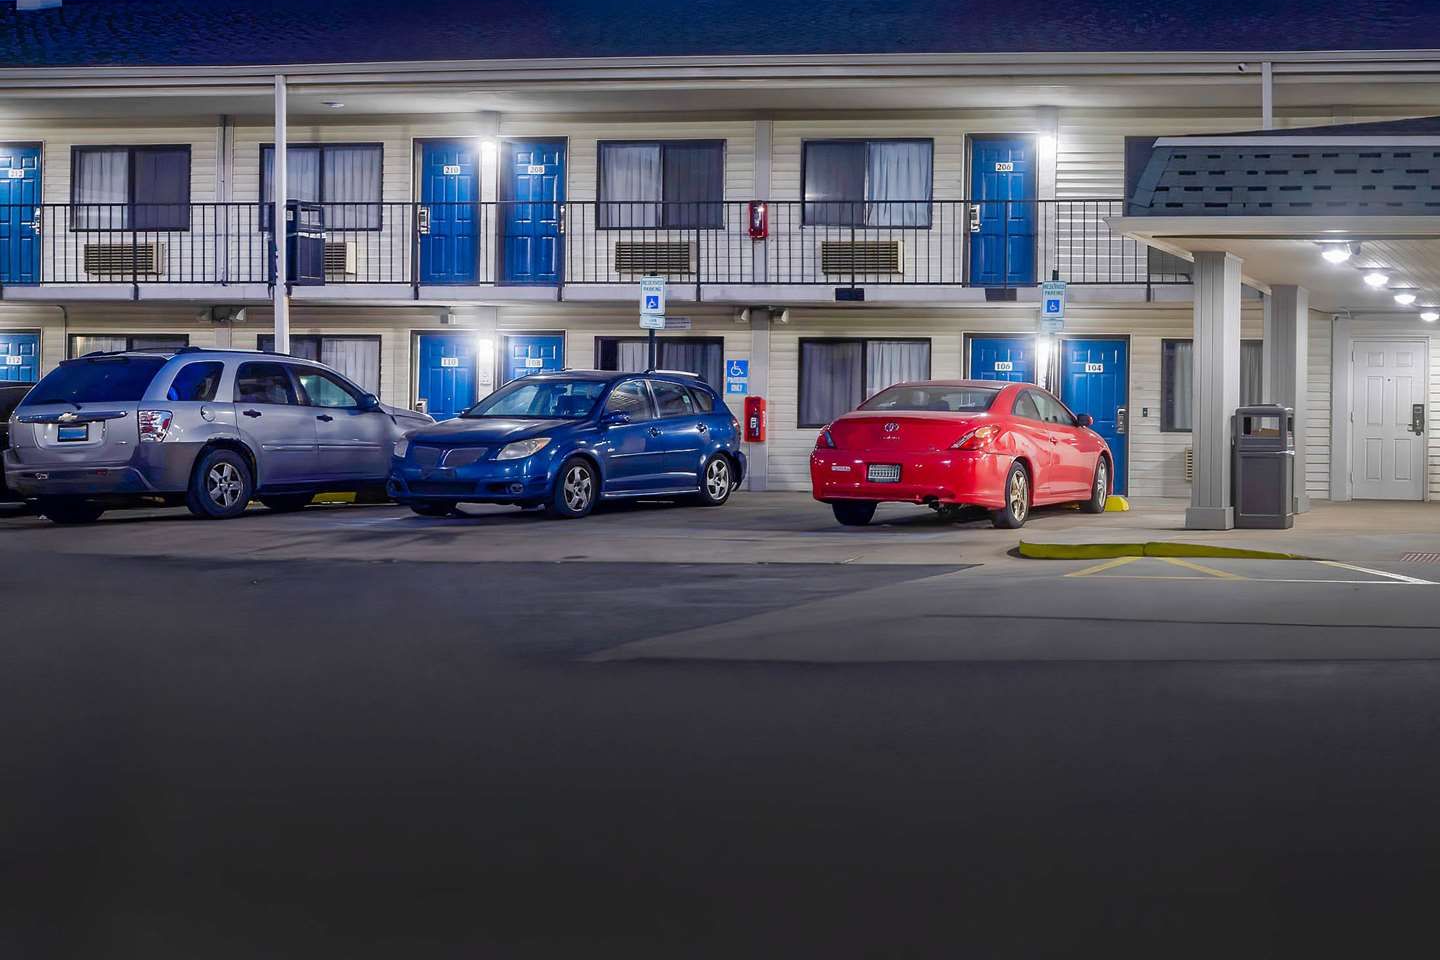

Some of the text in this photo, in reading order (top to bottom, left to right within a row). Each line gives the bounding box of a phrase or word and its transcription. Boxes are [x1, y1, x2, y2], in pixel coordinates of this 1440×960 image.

[997, 163, 1012, 171] 206
[996, 361, 1011, 370] 106
[1086, 364, 1102, 372] 104
